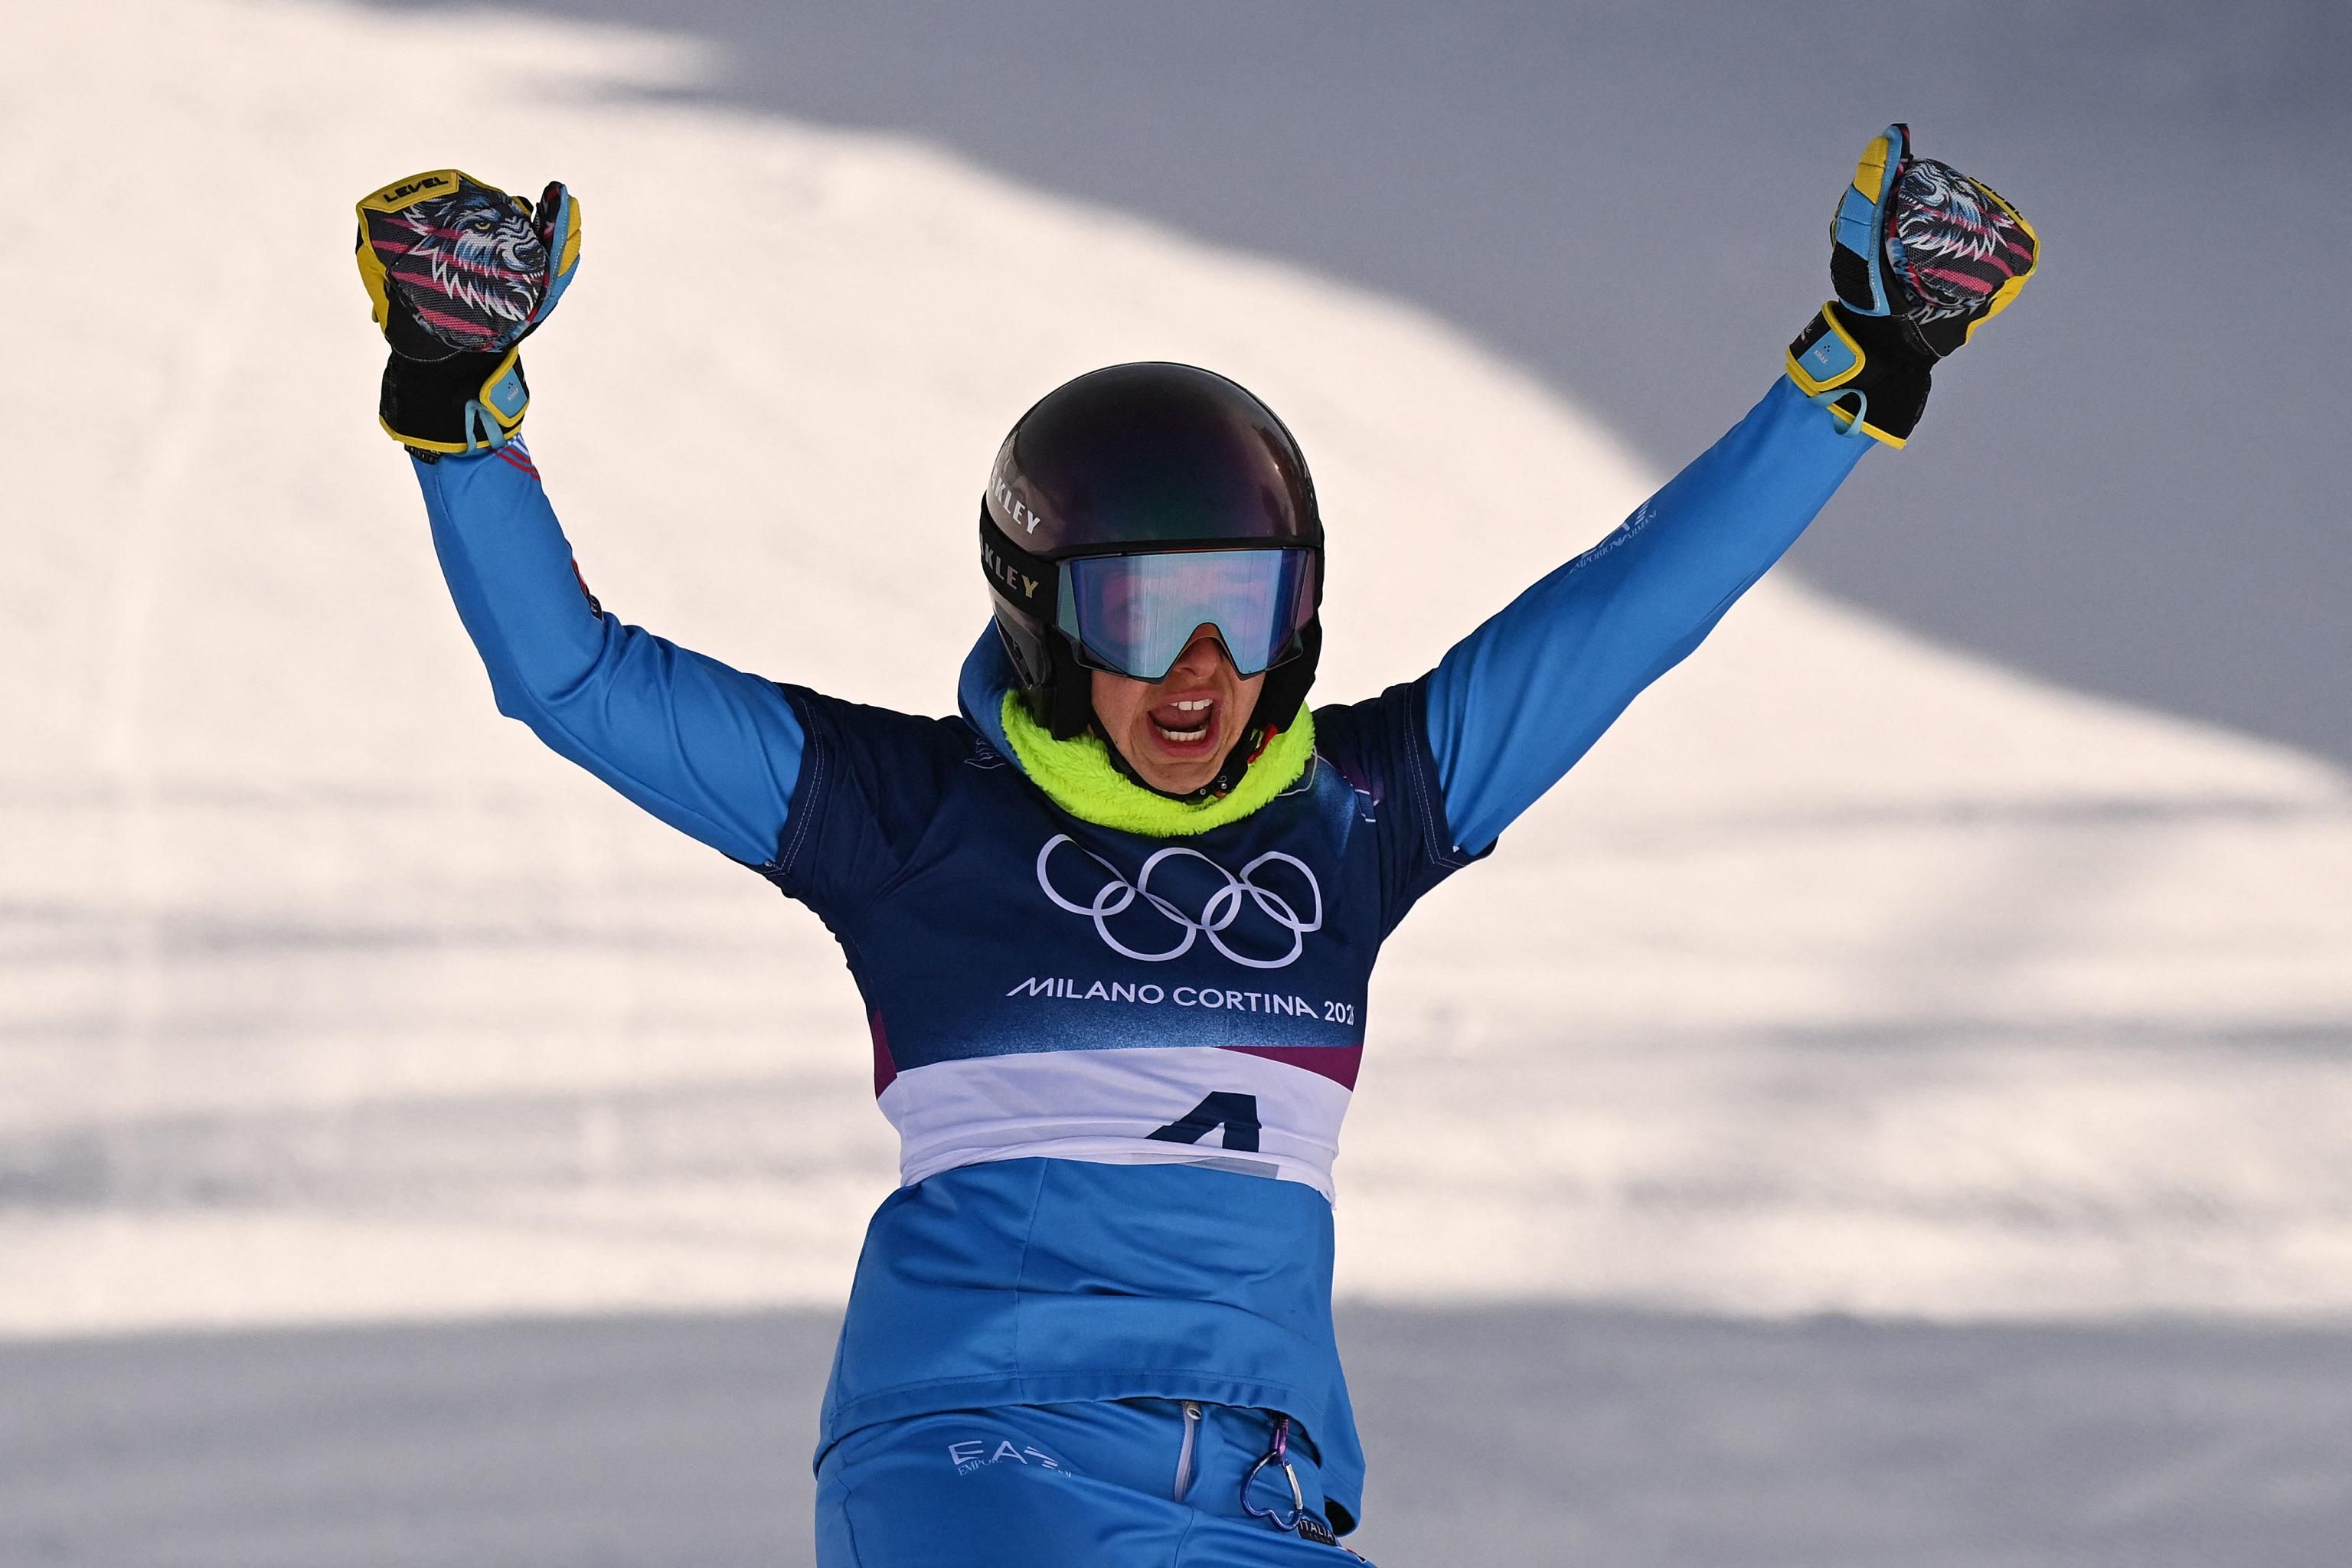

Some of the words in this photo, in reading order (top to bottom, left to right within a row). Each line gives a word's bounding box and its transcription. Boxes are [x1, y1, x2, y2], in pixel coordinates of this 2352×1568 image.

[383, 177, 449, 203] LEVEL
[1005, 977, 1165, 1004] MILANO
[1172, 986, 1319, 1019] CORTINA
[1324, 1000, 1354, 1027] 202
[1299, 1520, 1334, 1541] ITALIA
